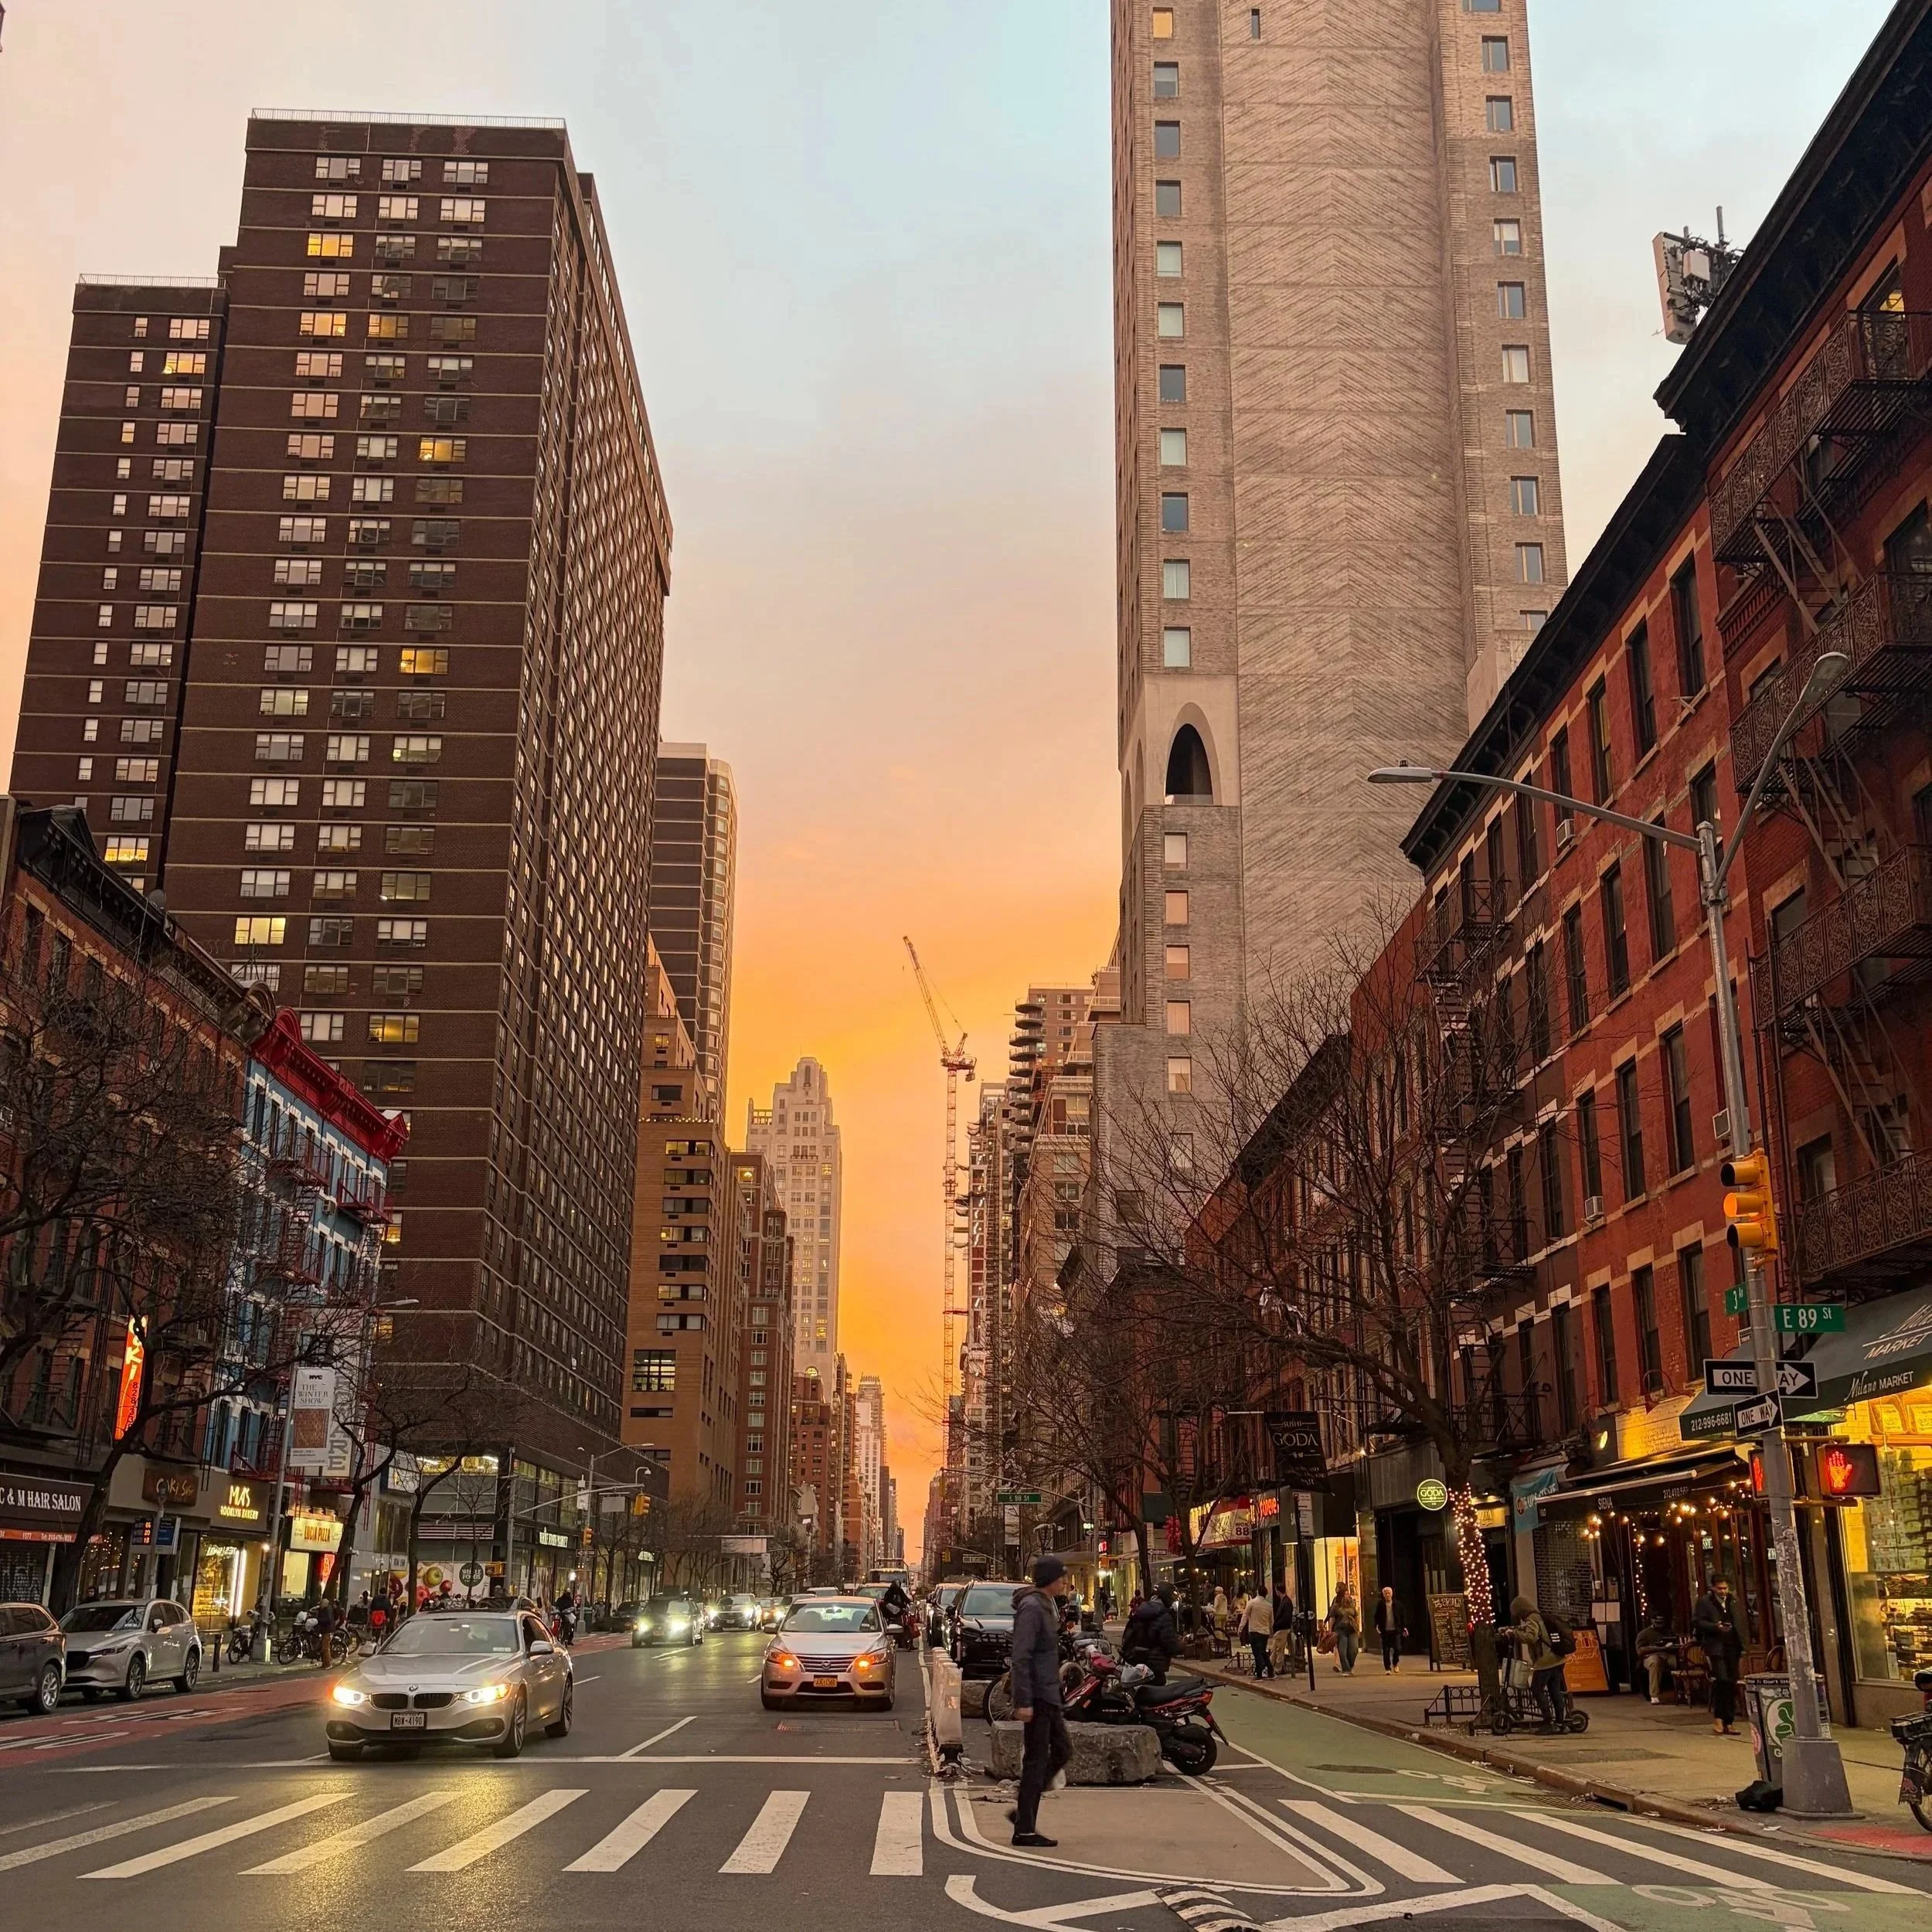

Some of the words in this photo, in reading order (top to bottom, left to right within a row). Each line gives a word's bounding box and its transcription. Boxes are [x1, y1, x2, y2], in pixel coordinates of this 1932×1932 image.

[1733, 1291, 1738, 1310] 3
[1783, 1308, 1793, 1328] E
[1798, 1308, 1817, 1328] 89
[1822, 1307, 1832, 1319] St
[1863, 1331, 1932, 1360] MARKET
[1722, 1371, 1753, 1385] ONE
[1779, 1372, 1798, 1386] AY
[1844, 1370, 1876, 1401] Milano
[1879, 1371, 1914, 1389] MARKET
[1691, 1411, 1732, 1431] 212-996-6681
[1741, 1408, 1754, 1426] ONE
[1759, 1403, 1774, 1420] WAY
[1272, 1433, 1319, 1446] GODA
[7, 1488, 15, 1505] &
[18, 1489, 26, 1507] M
[27, 1491, 50, 1510] HAIR
[52, 1493, 81, 1512] SALON
[1597, 1496, 1614, 1510] SIENA
[318, 1528, 331, 1543] PIZZA
[1235, 1527, 1250, 1536] 88
